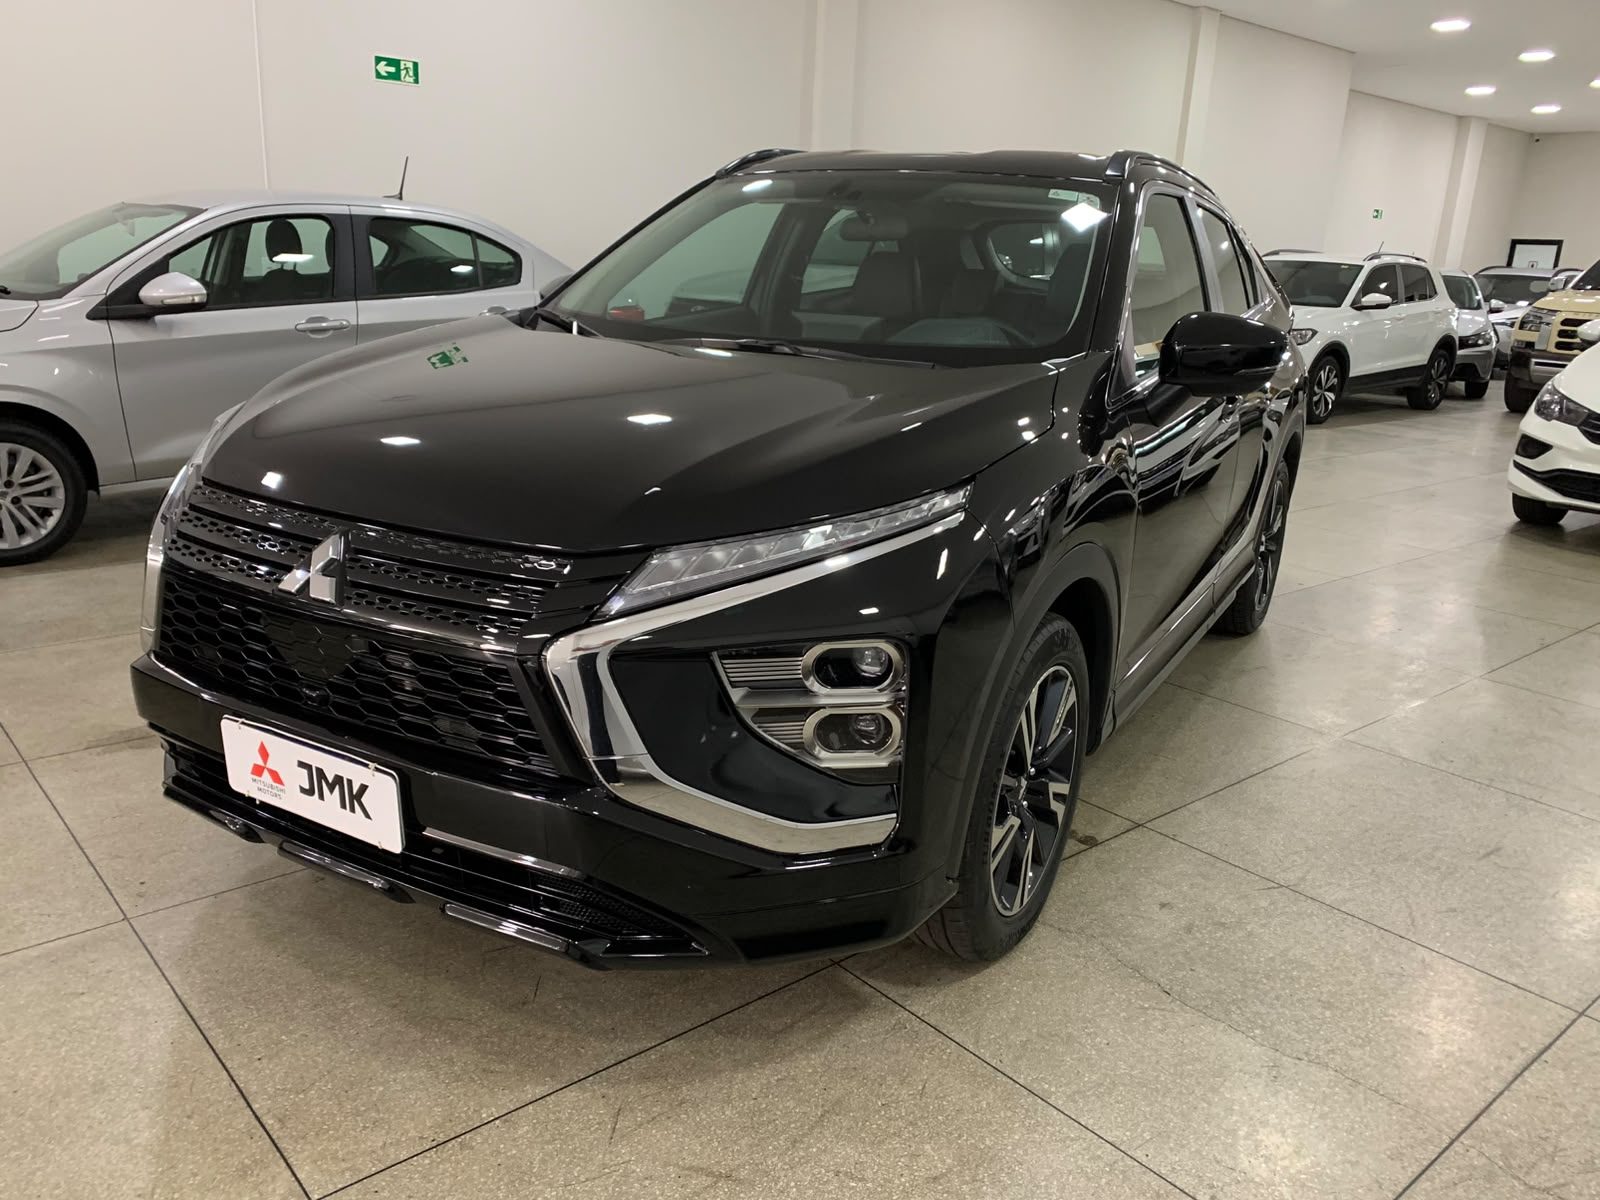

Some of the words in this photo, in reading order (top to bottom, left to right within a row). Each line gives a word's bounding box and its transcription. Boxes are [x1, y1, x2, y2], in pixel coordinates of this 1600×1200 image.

[251, 777, 286, 795] MITSUBISHI
[257, 786, 282, 800] MOTORS
[297, 760, 372, 821] JMK
